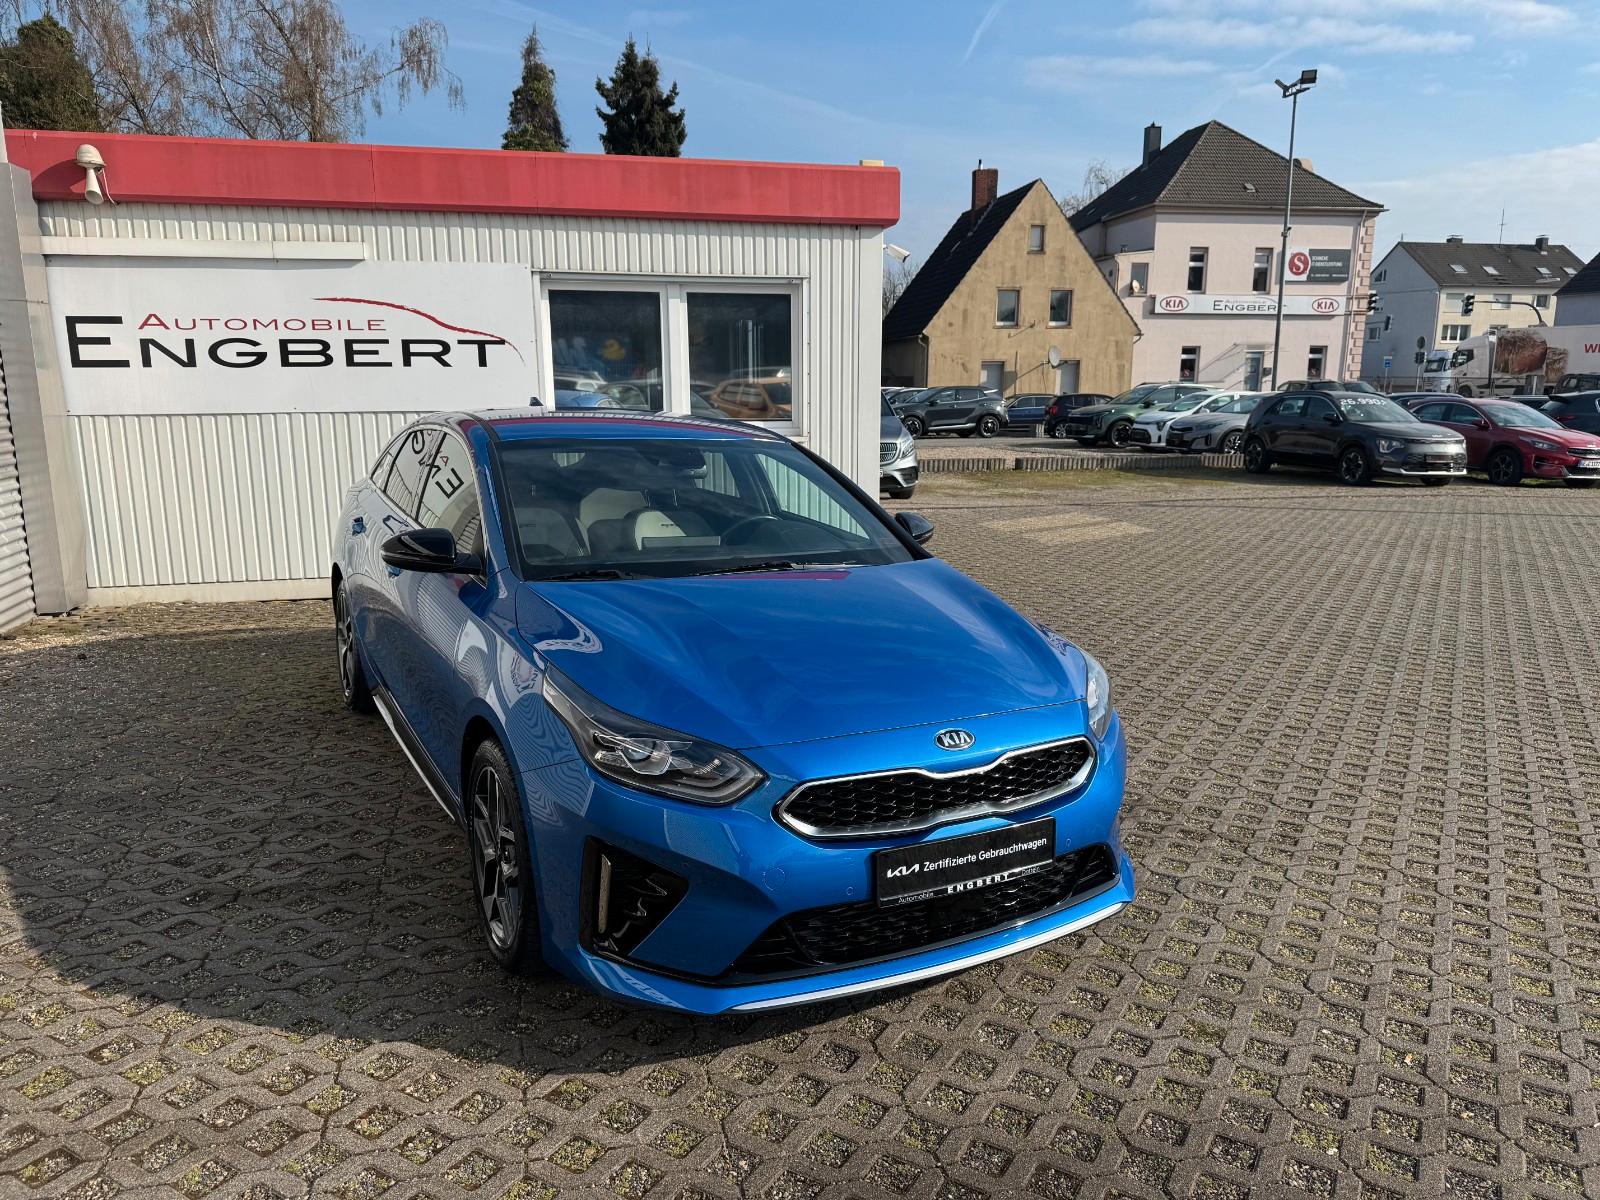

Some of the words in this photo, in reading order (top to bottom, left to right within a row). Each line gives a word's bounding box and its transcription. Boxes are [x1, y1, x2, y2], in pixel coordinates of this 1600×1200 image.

[1165, 297, 1184, 309] KIA
[1316, 299, 1335, 311] KIA
[138, 313, 387, 331] AUTOMOBILE
[65, 315, 506, 368] ENGBERT
[940, 732, 970, 746] KIA
[887, 863, 920, 878] KIA
[923, 854, 977, 872] Zertifizierte
[978, 838, 1047, 861] Gebrauchtwagen
[947, 872, 1009, 894] ENGBERT
